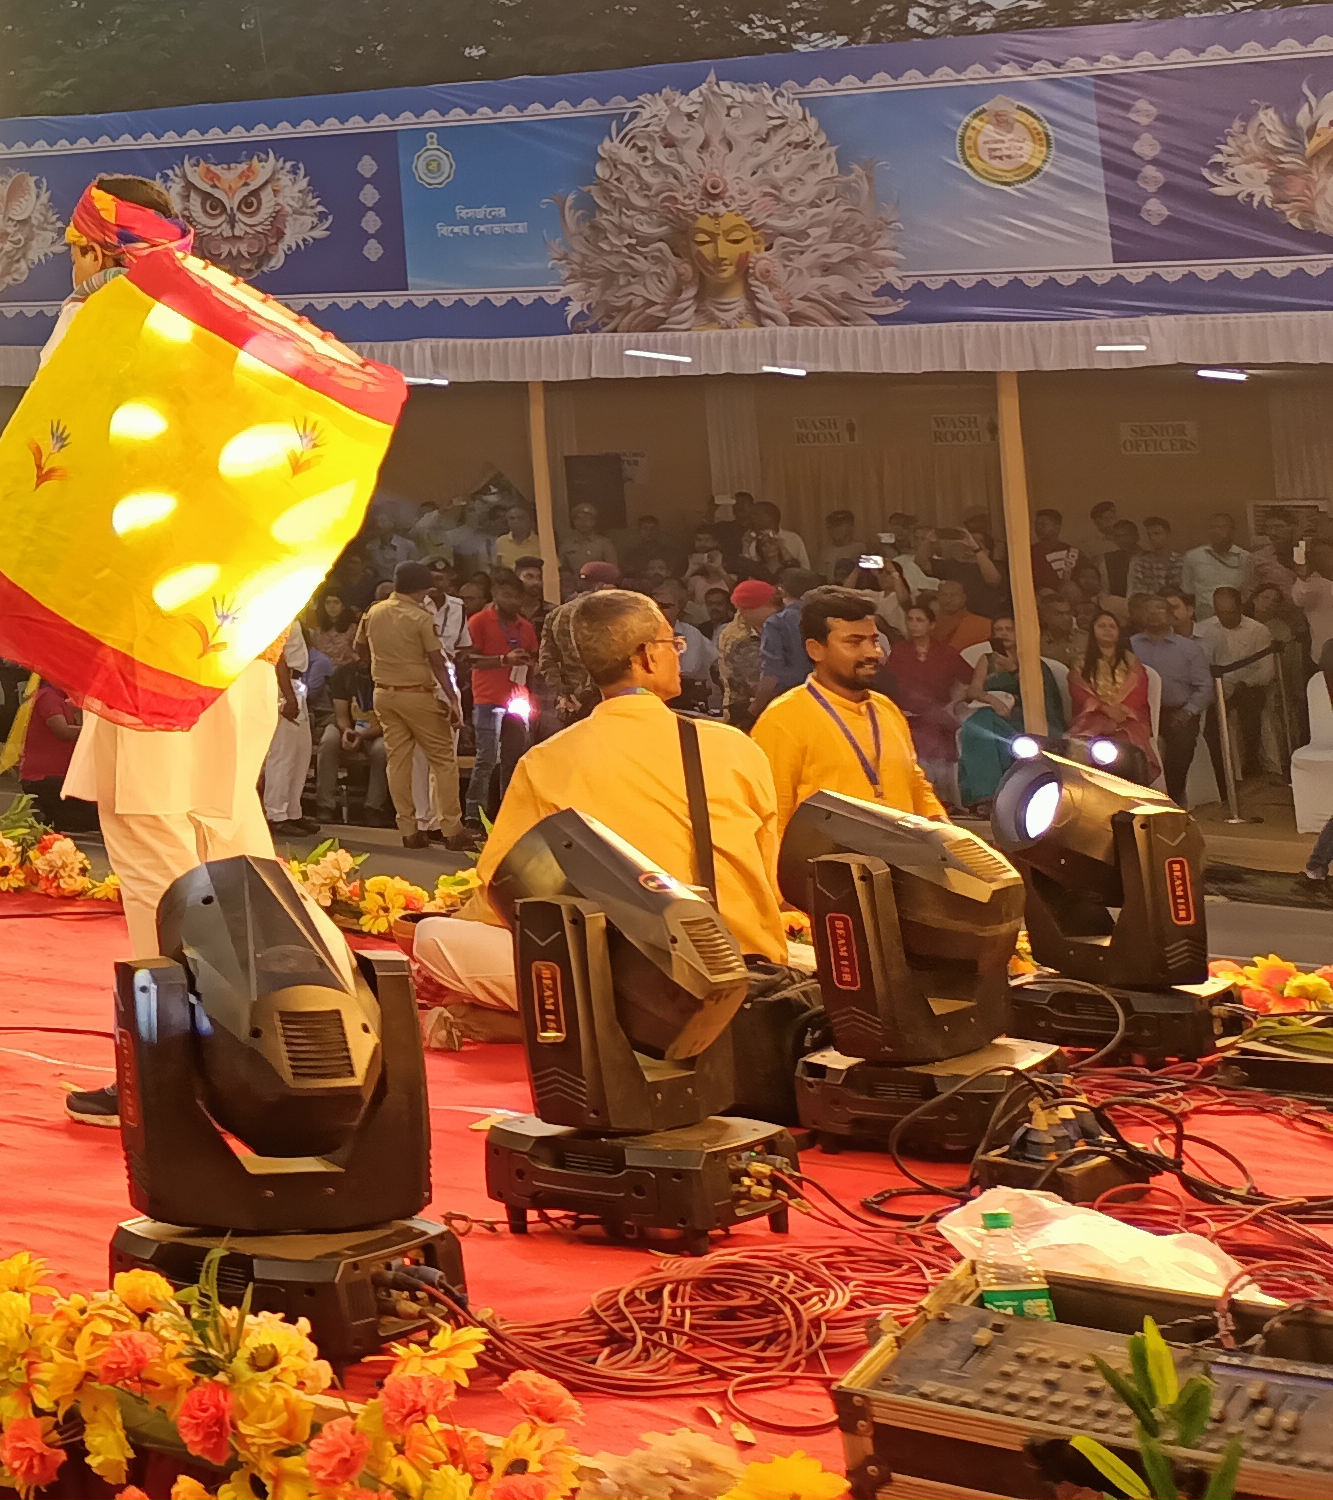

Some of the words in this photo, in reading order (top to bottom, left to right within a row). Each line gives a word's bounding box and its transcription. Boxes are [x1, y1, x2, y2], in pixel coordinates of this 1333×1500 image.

[455, 205, 506, 220] বিসর্জনের
[436, 222, 469, 237] বিশেষ
[473, 222, 528, 236] শোভাযাত্রা
[795, 418, 838, 430] WASH
[932, 417, 978, 429] WASH
[796, 431, 841, 444] ROOM
[933, 430, 982, 443] ROOM
[1130, 424, 1187, 437] SENIOR
[1123, 438, 1197, 452] OFFICERS
[1172, 863, 1184, 896] BEAM
[834, 920, 848, 957] BEAM
[541, 969, 555, 1010] BEAM
